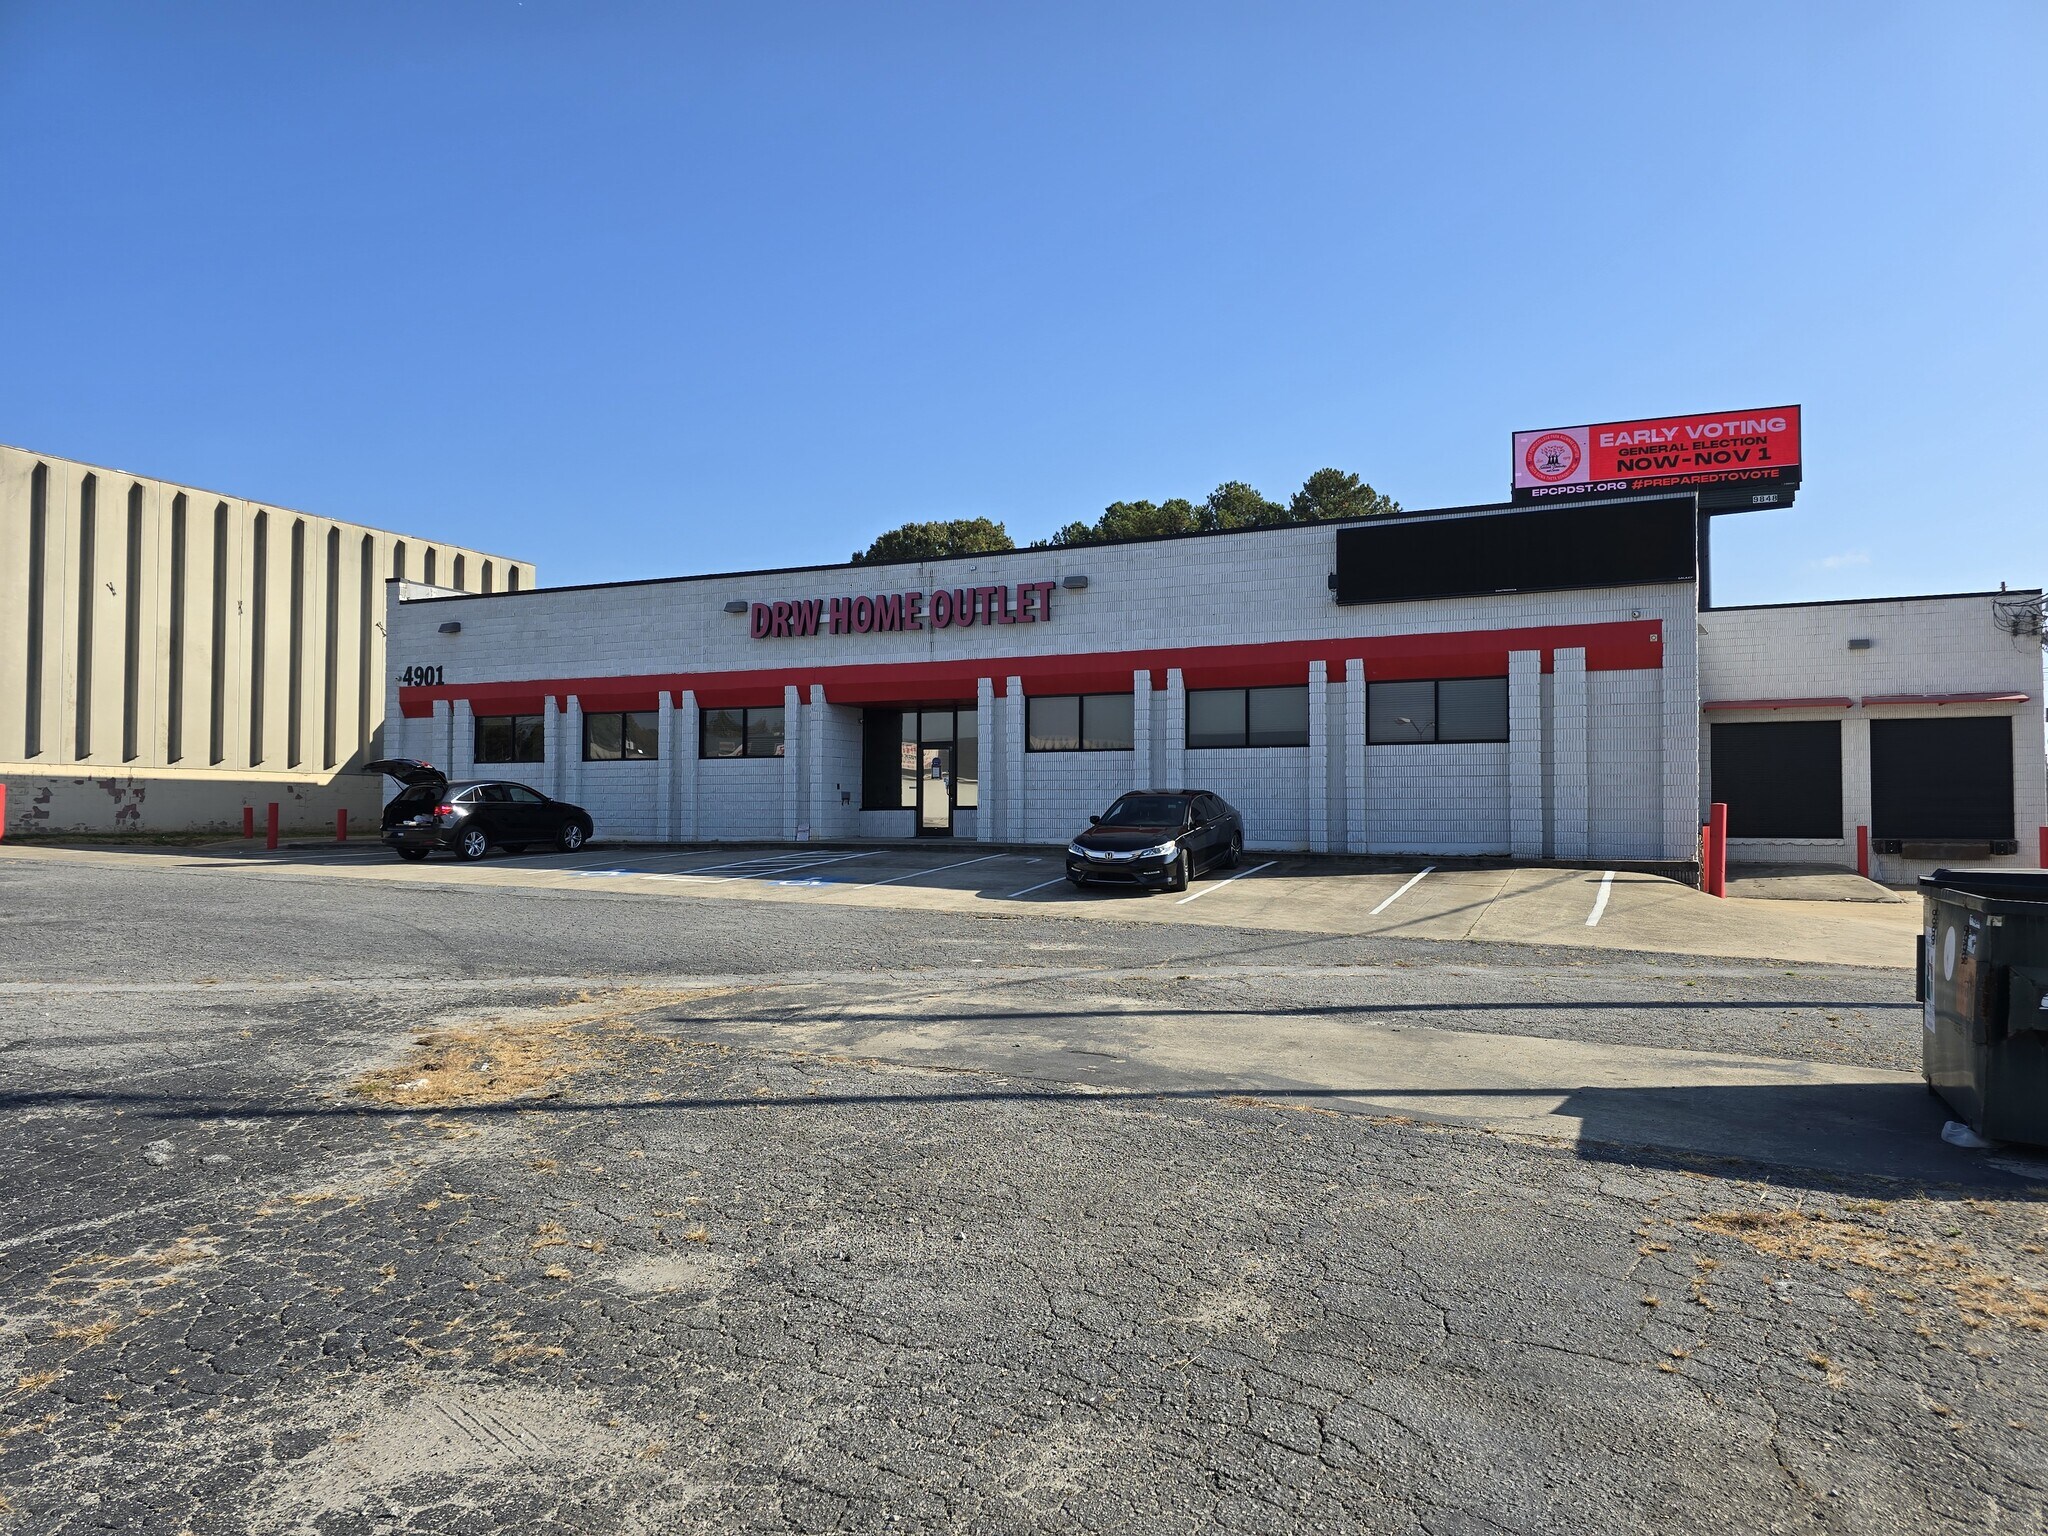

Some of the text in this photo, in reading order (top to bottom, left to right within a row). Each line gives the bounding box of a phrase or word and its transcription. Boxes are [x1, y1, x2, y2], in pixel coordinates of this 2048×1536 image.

[1600, 427, 1680, 447] EARLY
[1686, 418, 1786, 439] VOTING
[1618, 436, 1768, 457] GENERAL ELECTION
[1758, 447, 1772, 461] 1
[1532, 470, 1779, 497] EPCPDST.ORG #PREPAREDTOVOTE
[750, 581, 1056, 639] DRW HOME OUTLET
[403, 666, 444, 686] 4901
